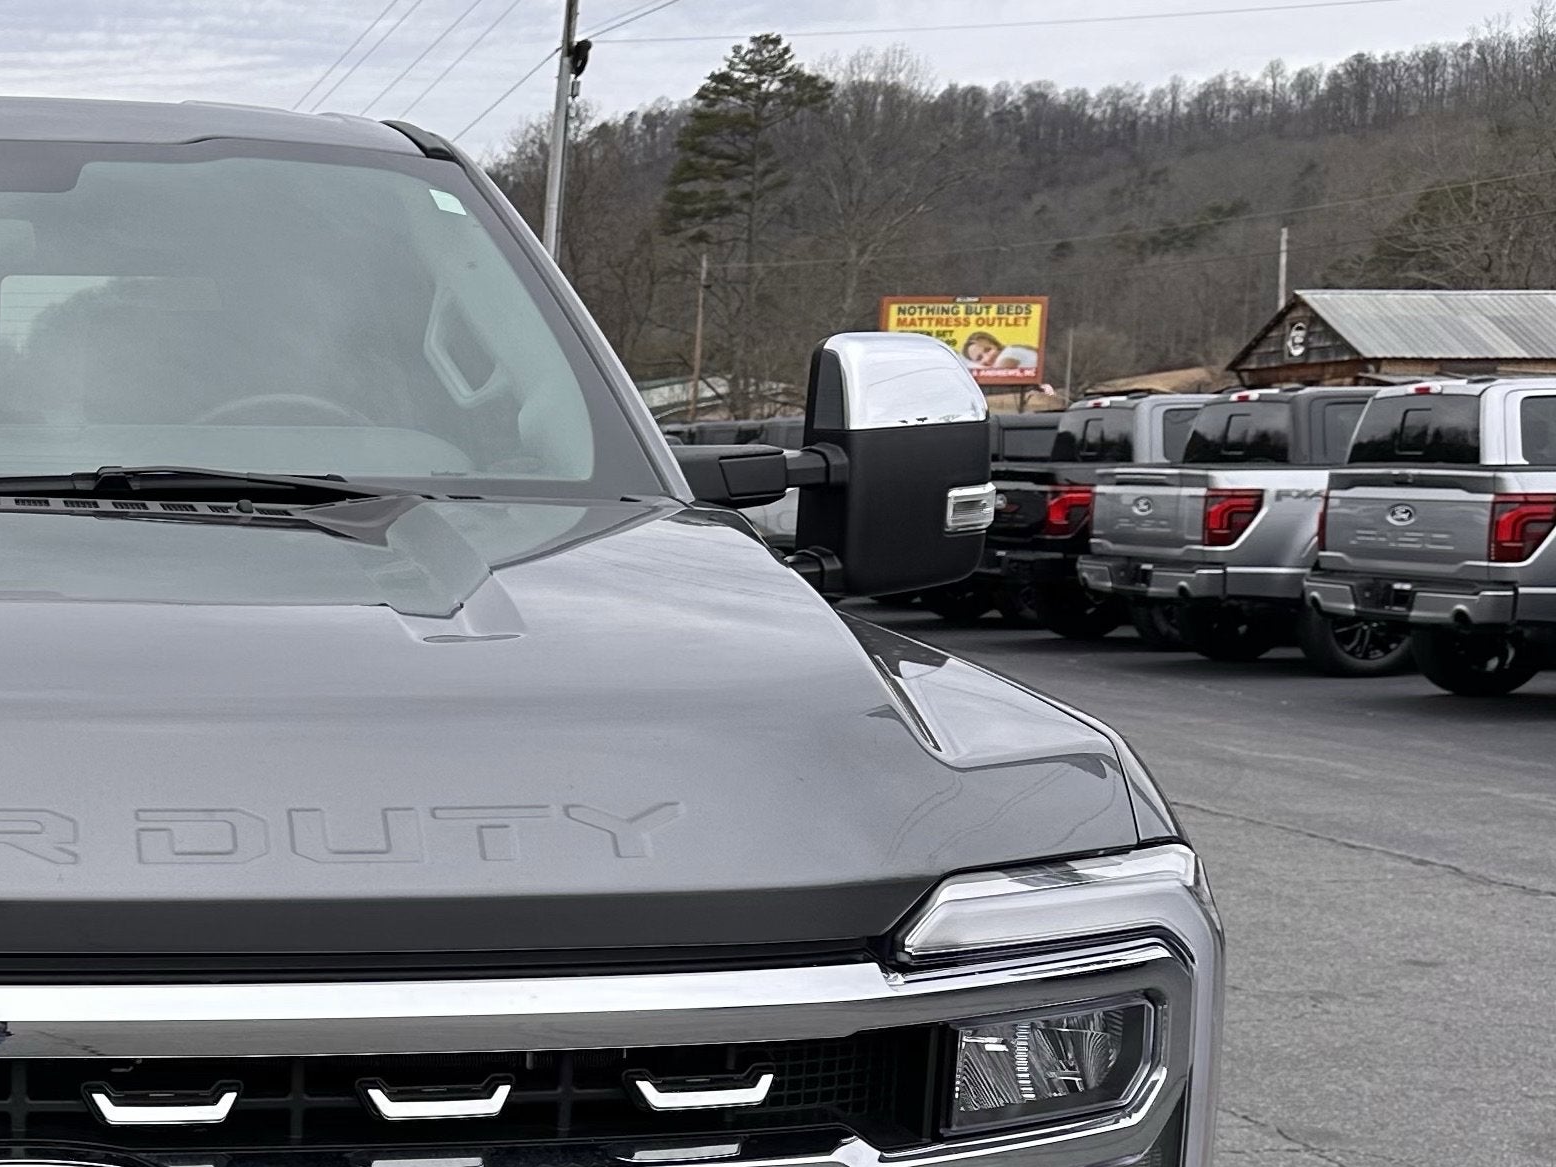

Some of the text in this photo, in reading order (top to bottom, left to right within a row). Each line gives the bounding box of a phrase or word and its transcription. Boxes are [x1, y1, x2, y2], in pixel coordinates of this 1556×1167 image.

[897, 304, 1032, 316] NOTHING BUT BEDS
[896, 316, 1030, 328] MATTRESS OUTLET
[136, 801, 684, 866] DUTY
